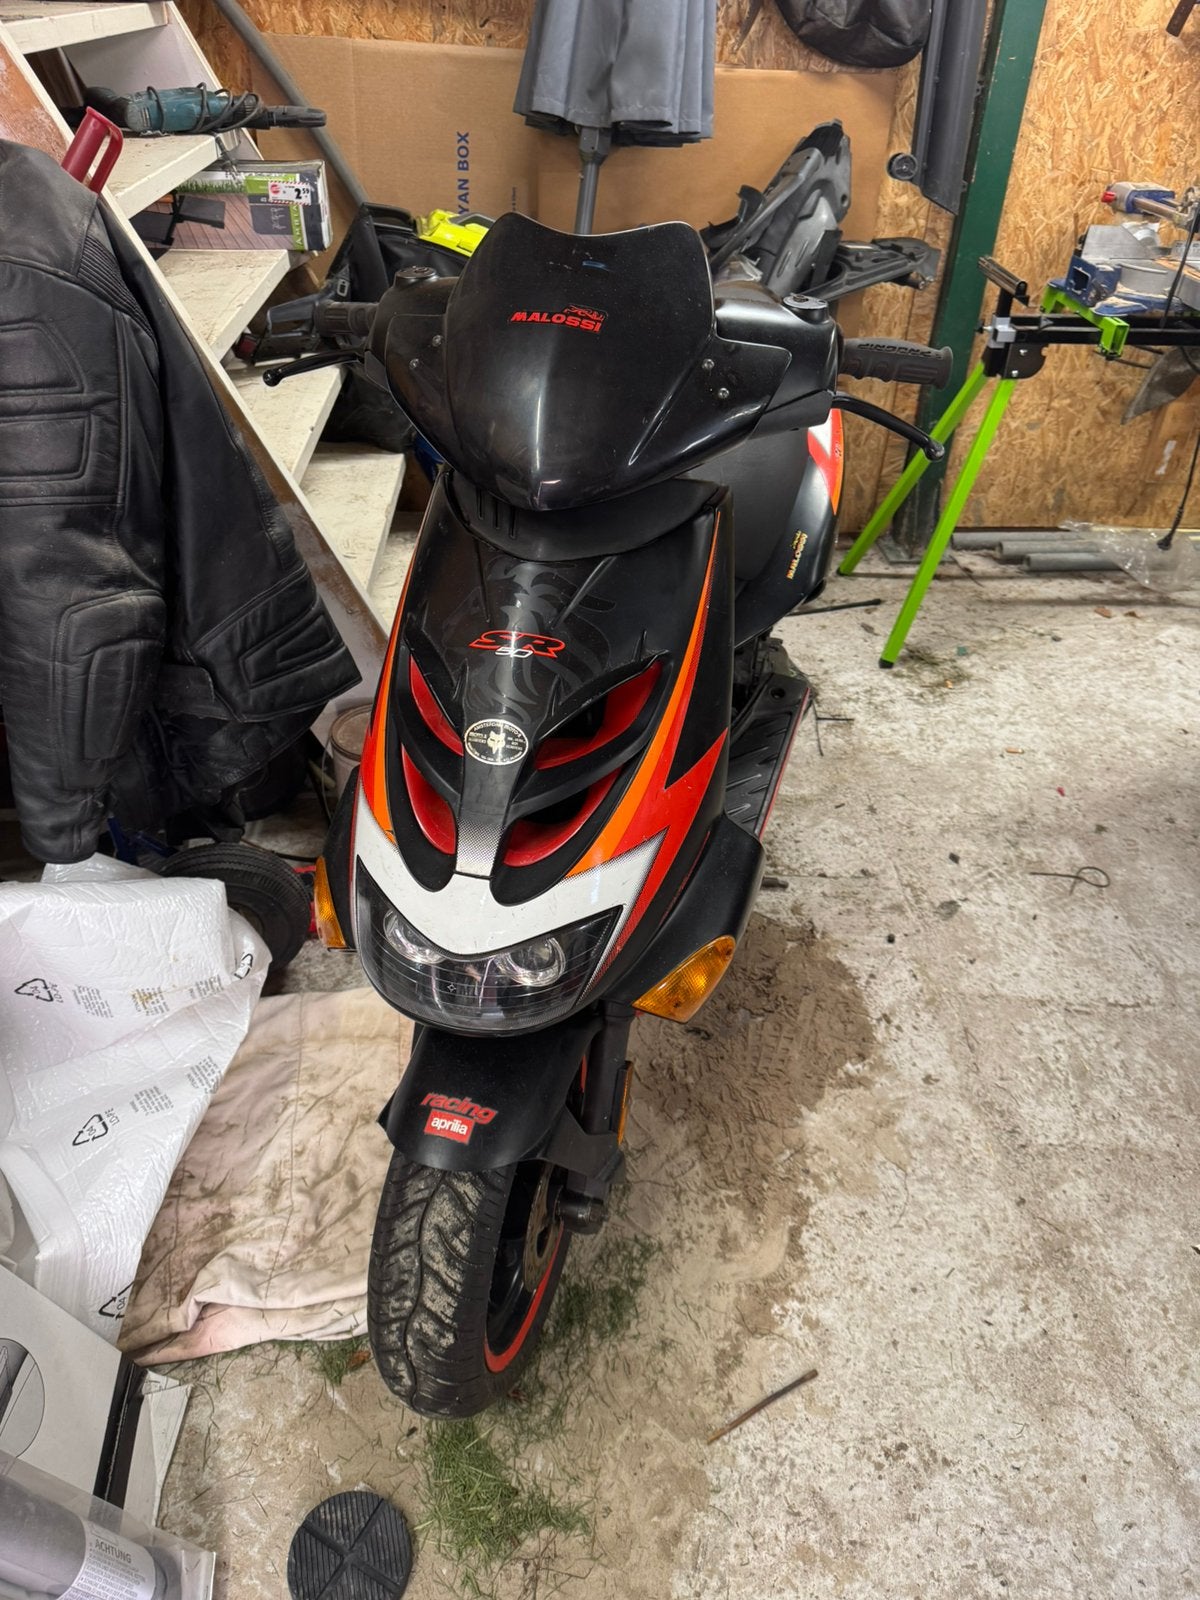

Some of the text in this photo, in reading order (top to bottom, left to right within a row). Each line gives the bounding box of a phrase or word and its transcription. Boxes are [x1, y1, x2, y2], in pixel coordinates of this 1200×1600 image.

[457, 131, 470, 171] BOX
[510, 311, 603, 333] MALOSSI
[420, 1092, 499, 1125] racing
[430, 1117, 468, 1136] aprilia
[94, 1538, 132, 1564] ACHTUNG
